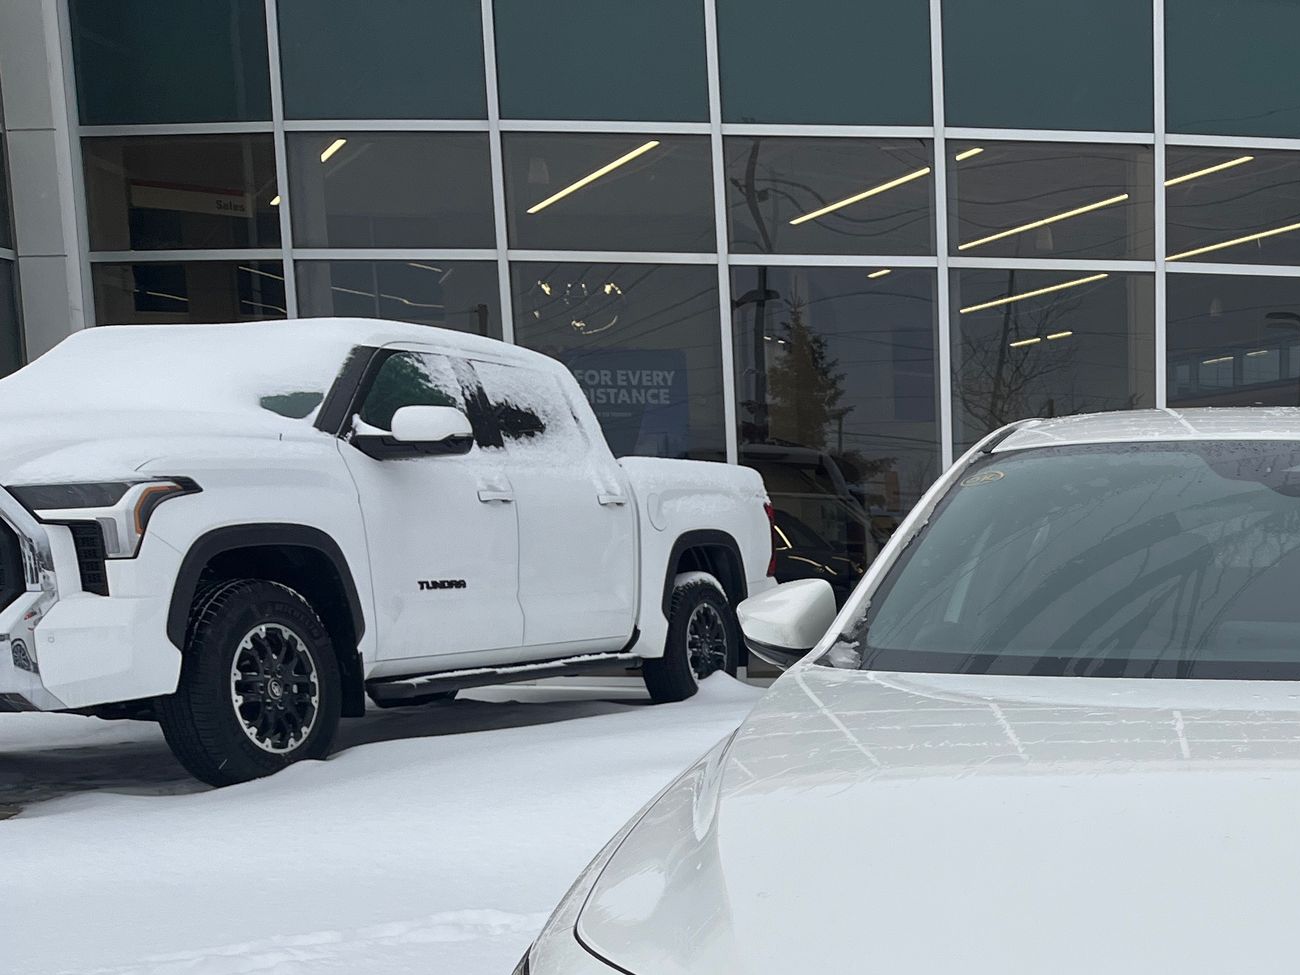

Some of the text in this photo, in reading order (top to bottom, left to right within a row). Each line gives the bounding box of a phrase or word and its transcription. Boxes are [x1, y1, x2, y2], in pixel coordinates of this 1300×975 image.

[616, 369, 675, 386] EVERY
[583, 387, 670, 404] ISTANCE
[417, 579, 467, 591] TUNDRA
